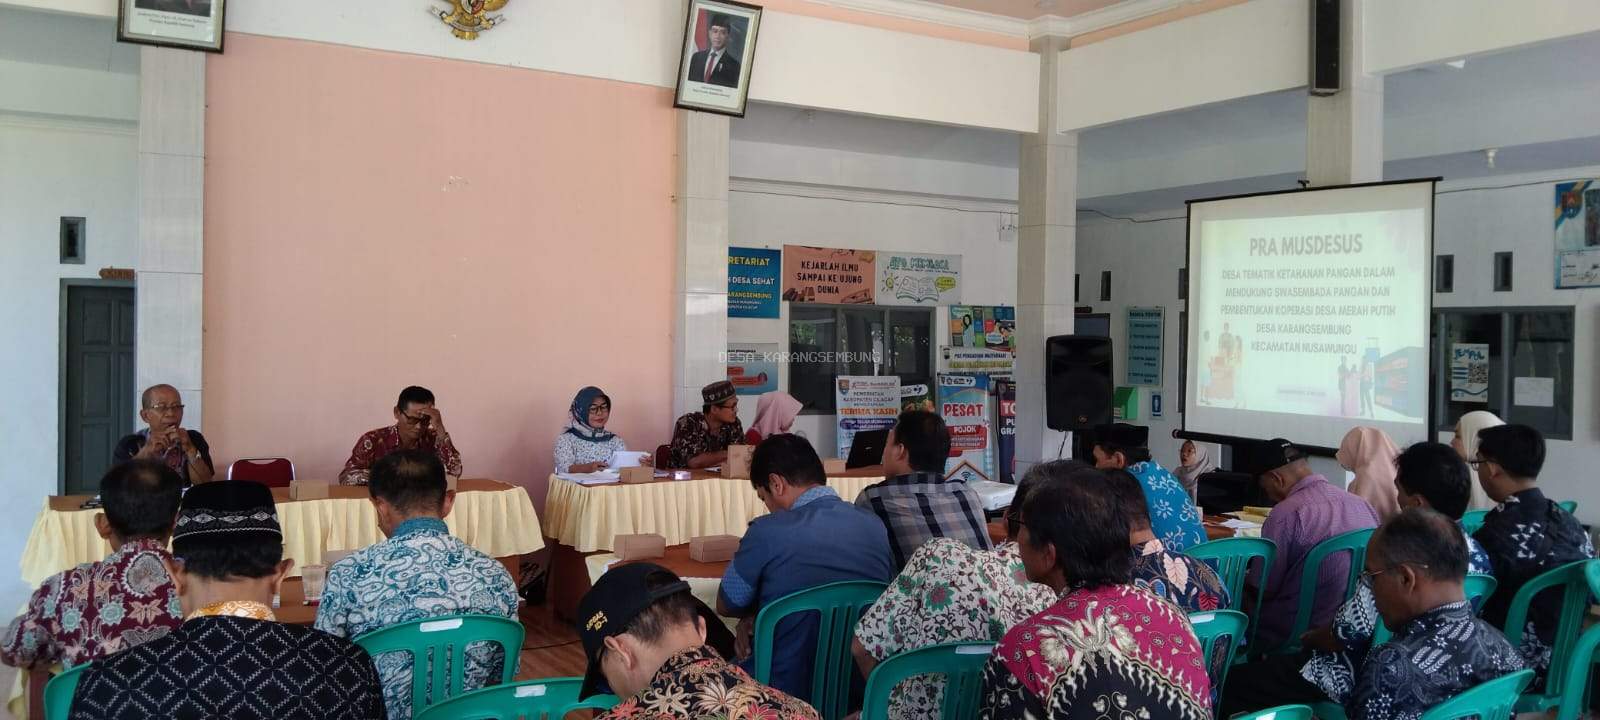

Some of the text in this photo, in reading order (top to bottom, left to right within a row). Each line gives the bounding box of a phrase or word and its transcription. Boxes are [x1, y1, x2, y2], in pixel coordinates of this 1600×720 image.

[1250, 233, 1363, 257] PRA MUSDESUS
[801, 260, 859, 272] KEJARLAH ILMU
[797, 272, 863, 284] SAMPAI KE UJUNG
[1222, 265, 1396, 280] DESA TEMATIK KETAHANAN PANGAN DALAM
[733, 276, 751, 284] DESA
[752, 277, 775, 285] SEHAT
[817, 284, 840, 294] DUNIA
[1225, 286, 1391, 298] MENDUKUNG SWASEMBADA PANGAN DAN
[1220, 304, 1397, 317] PEMBENTUKAN KOPERASI DESA MERAH PUTIH
[1256, 322, 1352, 336] DESA KARANGSEMBUNG
[1251, 341, 1357, 355] KECAMATAN NUSAWUNGU
[943, 403, 984, 417] PESAT
[953, 425, 977, 434] POJOK
